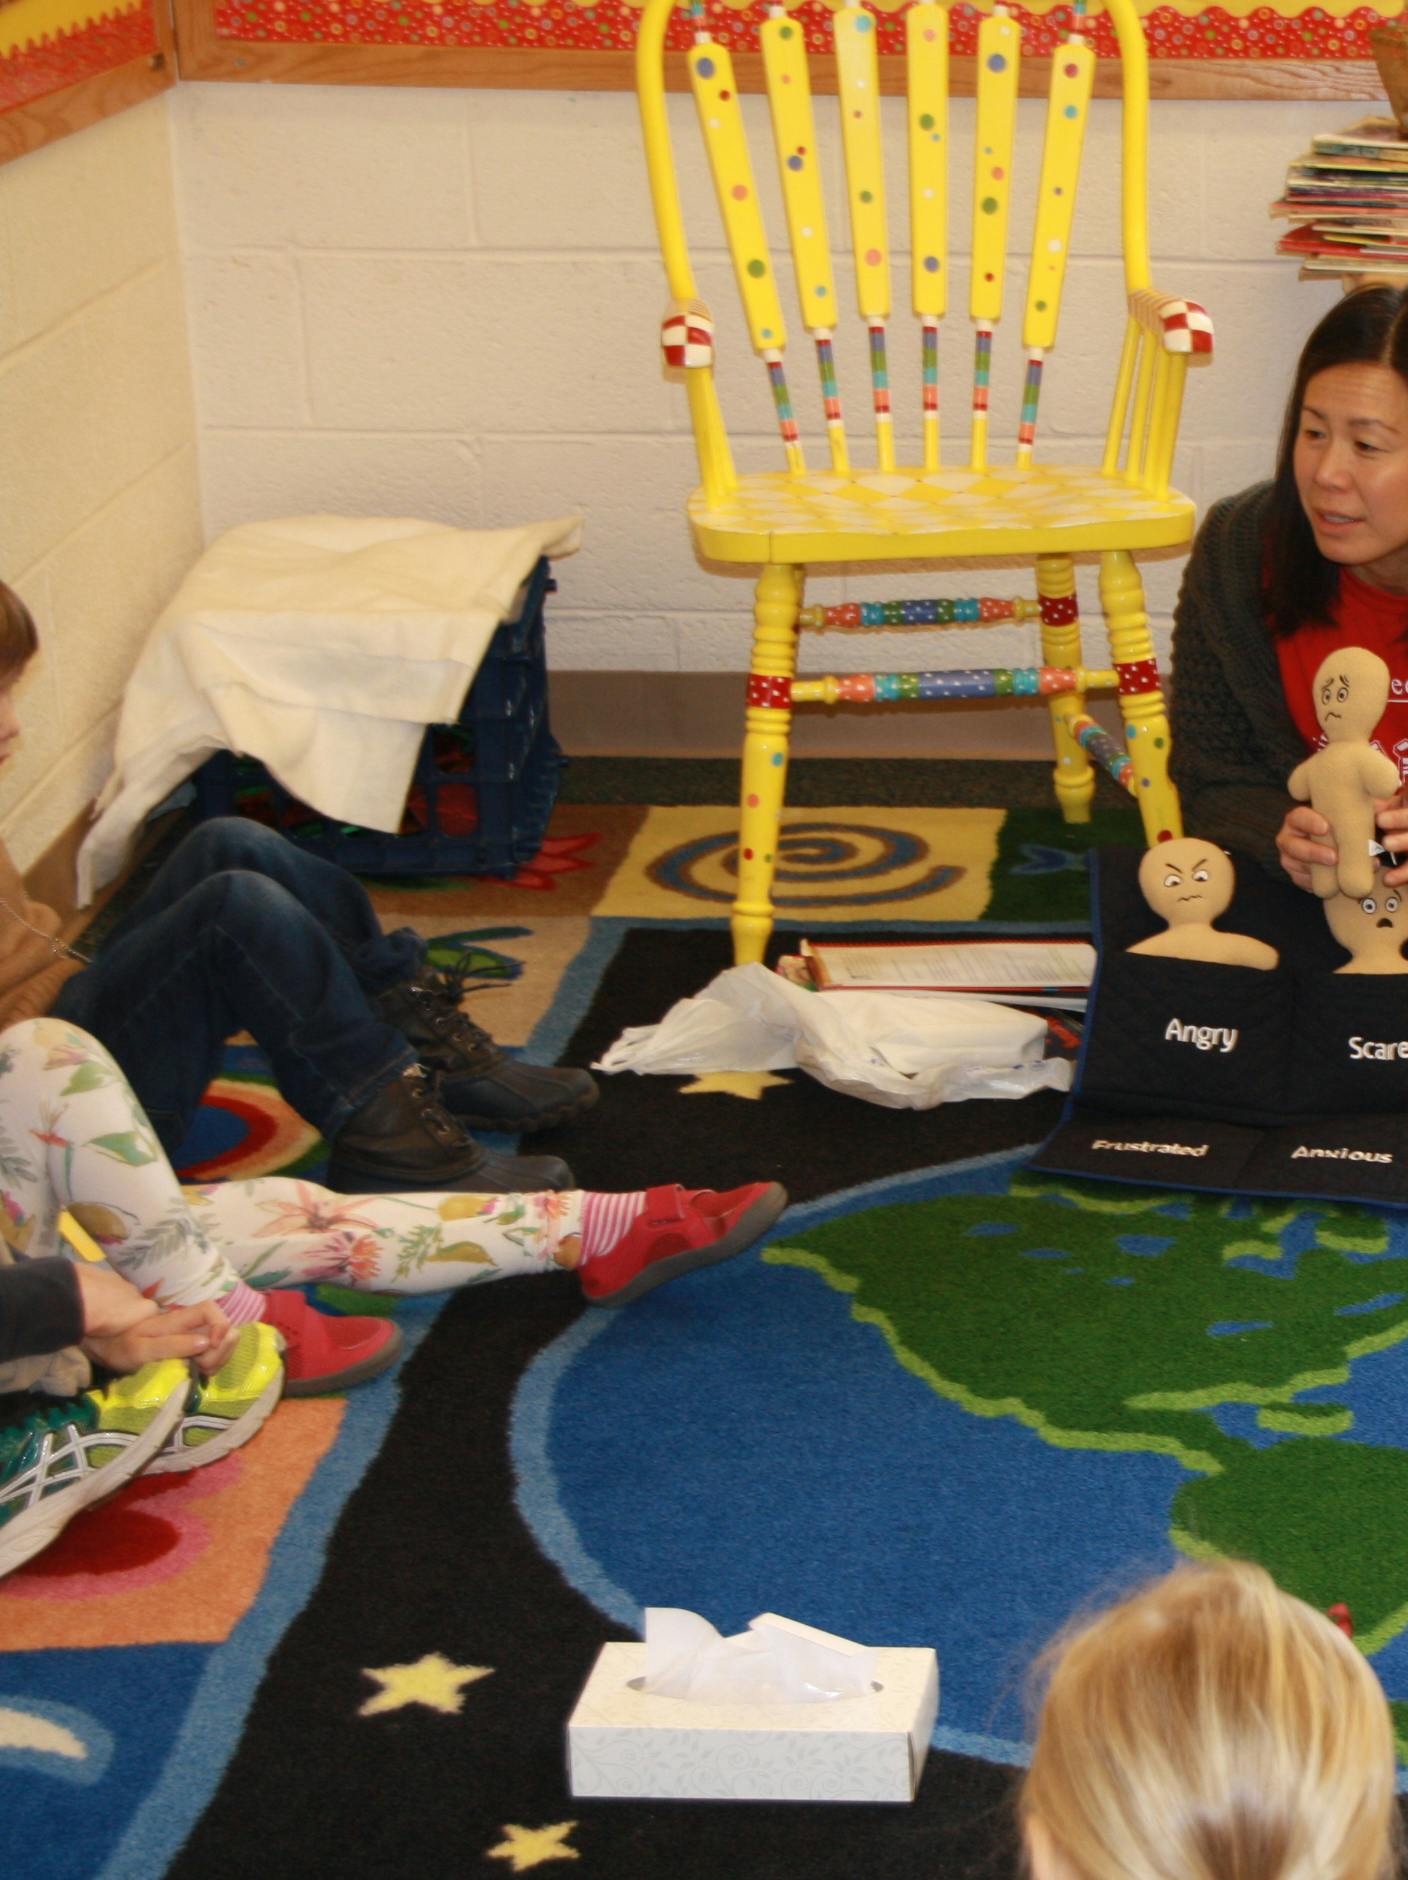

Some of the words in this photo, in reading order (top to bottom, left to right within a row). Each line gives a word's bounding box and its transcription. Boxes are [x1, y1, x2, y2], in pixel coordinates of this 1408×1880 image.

[1165, 1017, 1238, 1053] Angry
[1092, 1139, 1209, 1157] Frustrated
[1290, 1145, 1393, 1164] Anxious
